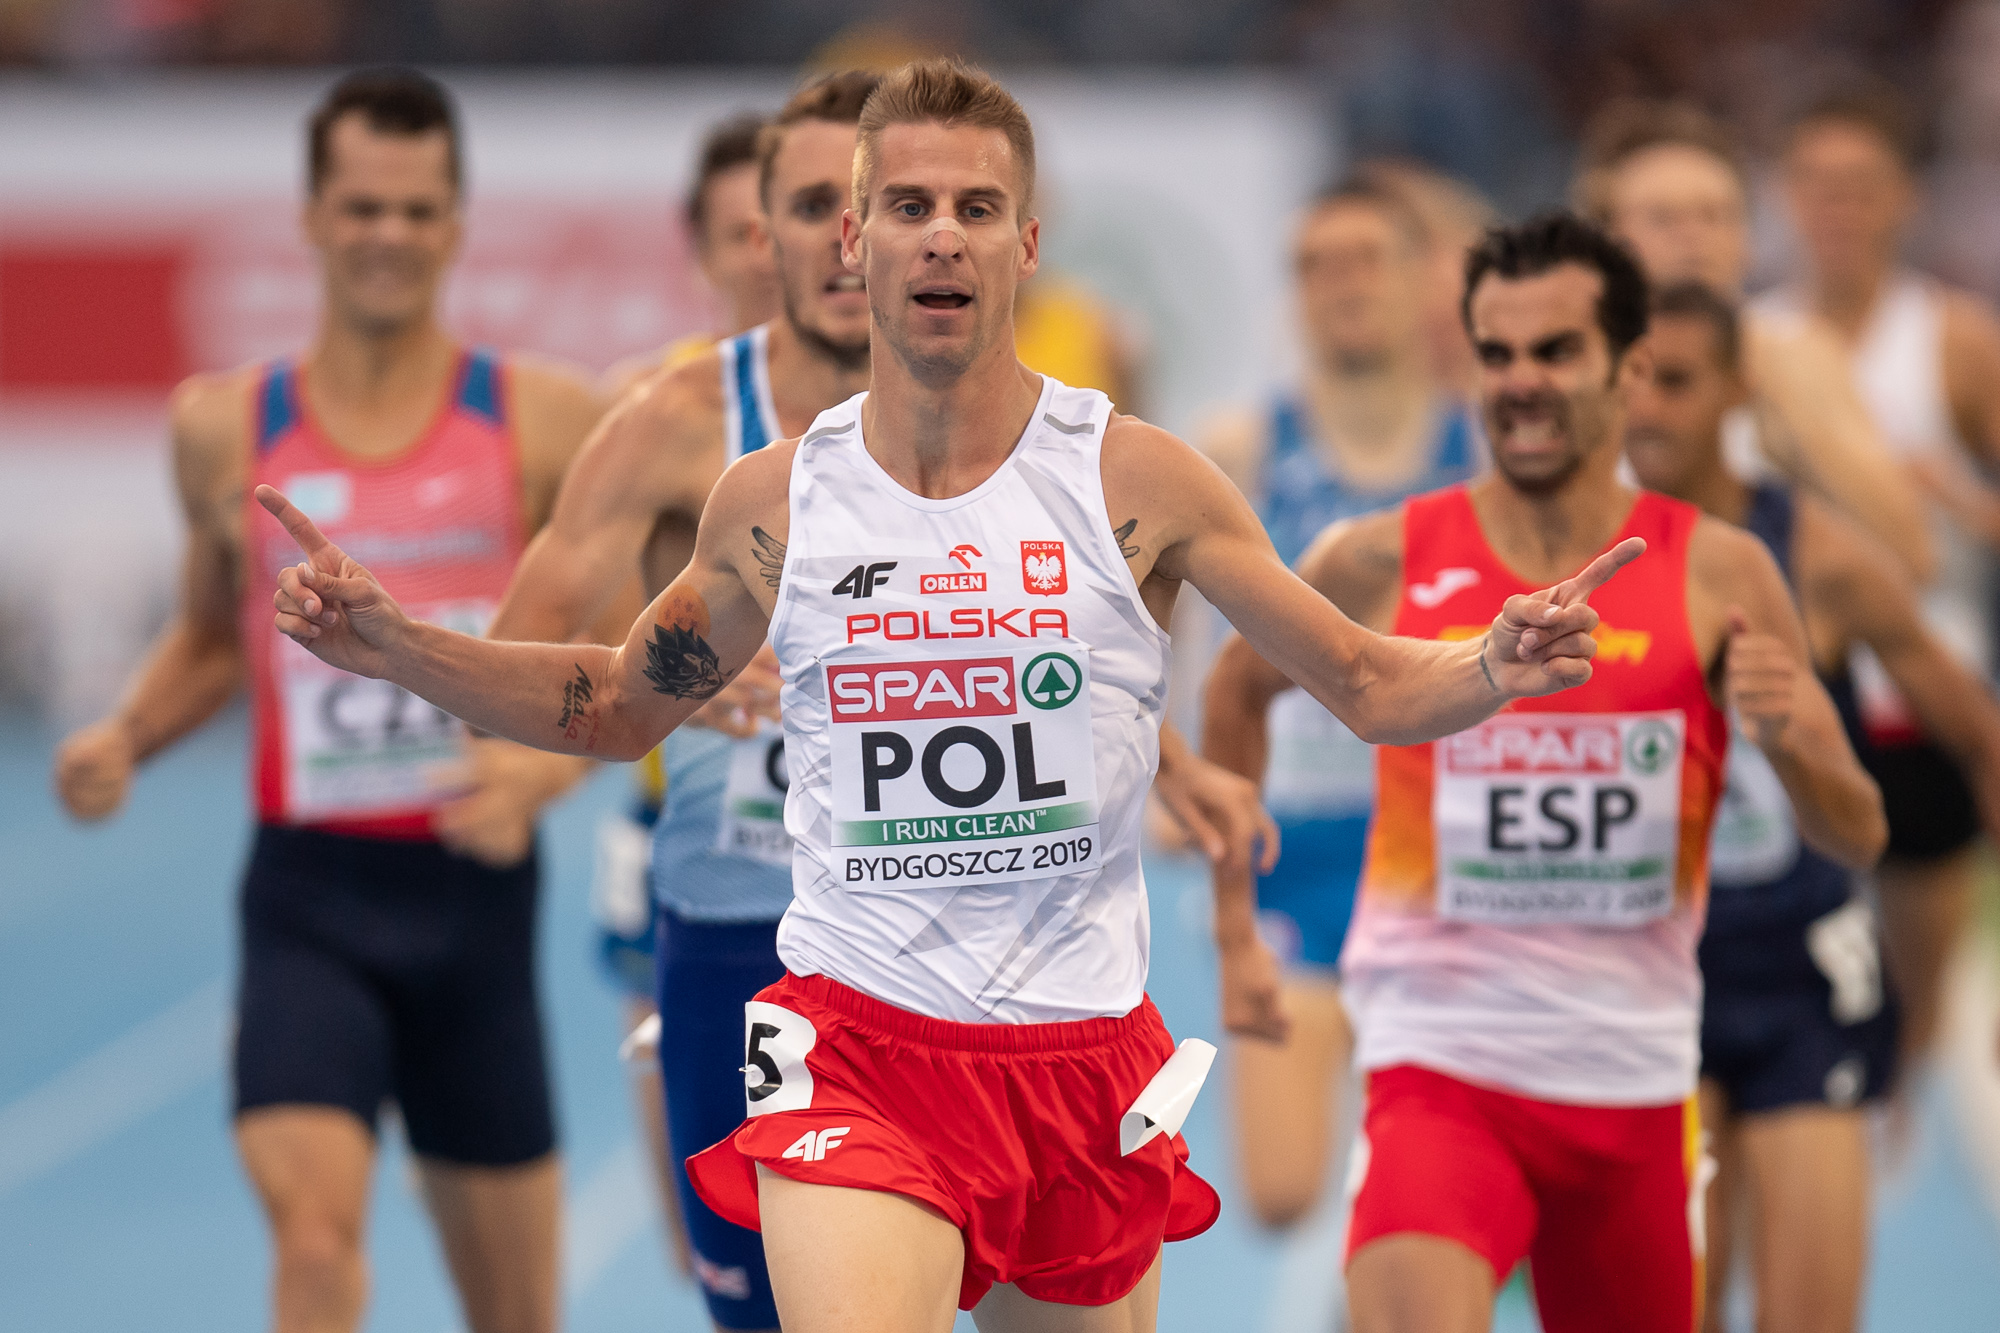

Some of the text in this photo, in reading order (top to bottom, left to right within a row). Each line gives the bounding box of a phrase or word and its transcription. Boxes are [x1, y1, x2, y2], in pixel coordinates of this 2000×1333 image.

[1023, 542, 1061, 550] POLSKA
[831, 561, 898, 599] 4F
[923, 575, 983, 592] ORLEN
[847, 608, 1069, 644] POLSKA
[833, 666, 1011, 714] SPAR
[861, 722, 1067, 812] POL
[1450, 725, 1615, 769] SPAR
[882, 822, 889, 841] I
[896, 820, 948, 841] RUN
[1488, 786, 1638, 853] ESP
[846, 837, 1093, 882] BYDGOSZCZ 2019
[748, 1022, 783, 1102] 5
[782, 1127, 851, 1162] 4F
